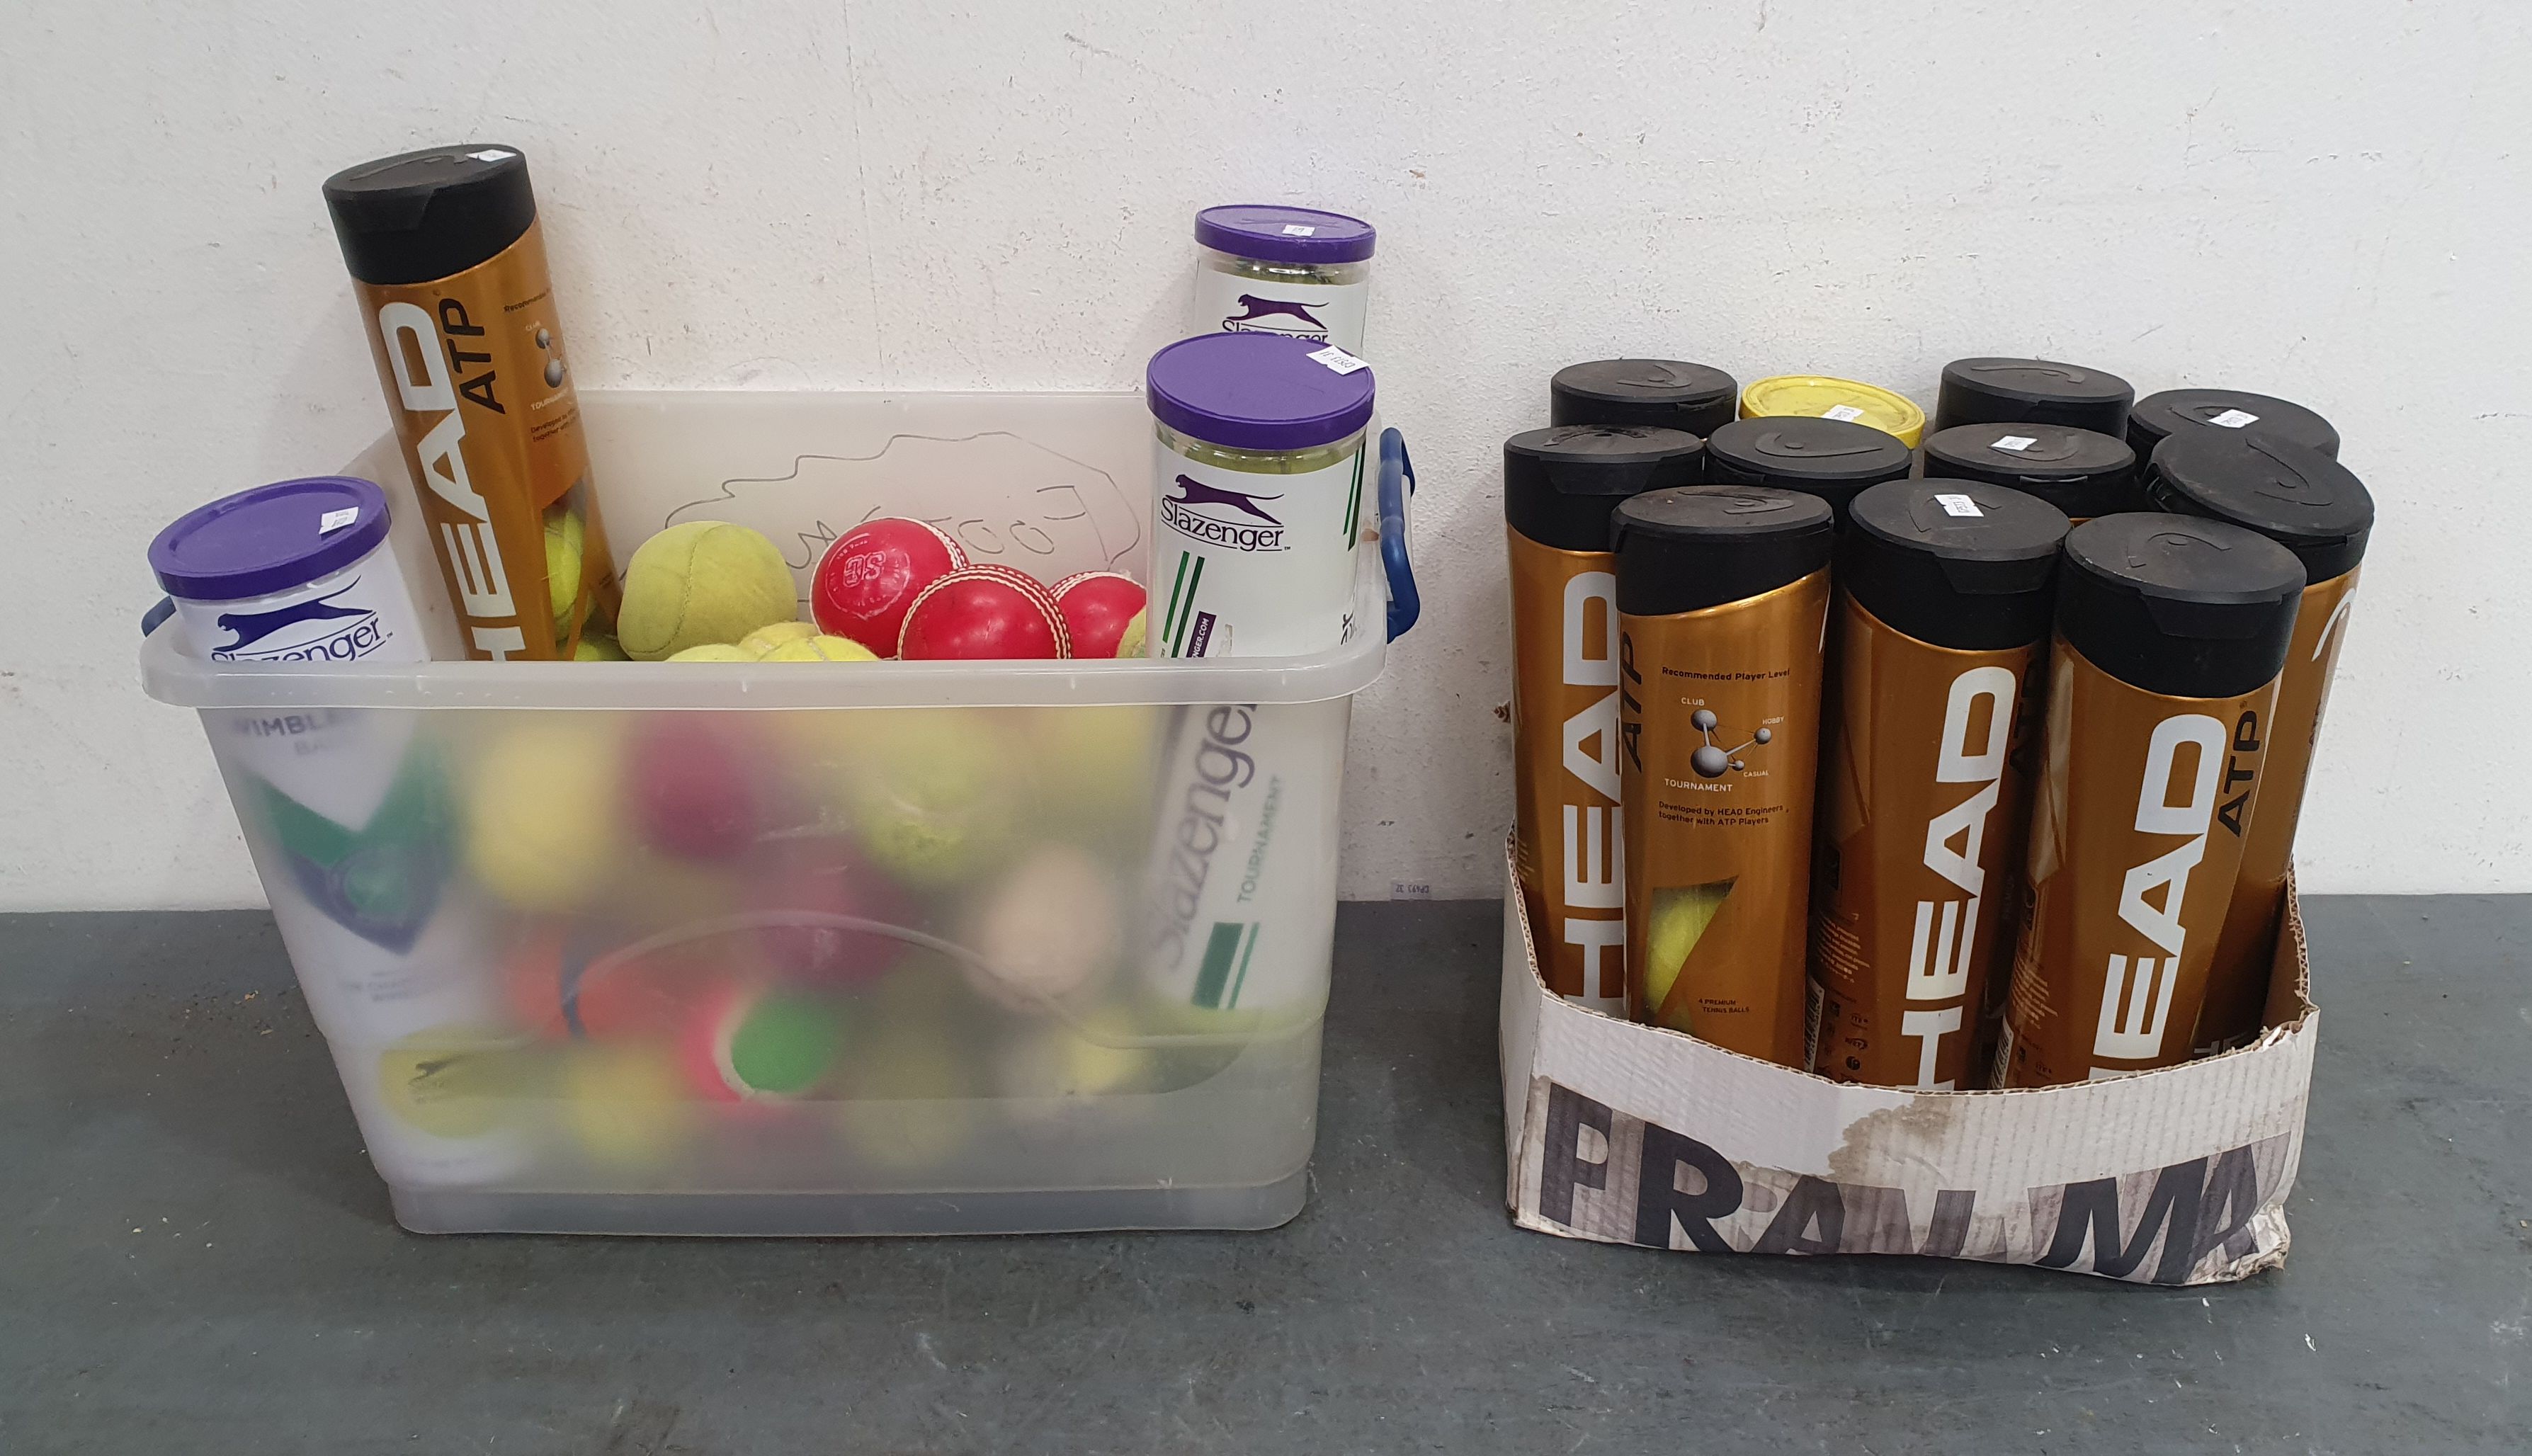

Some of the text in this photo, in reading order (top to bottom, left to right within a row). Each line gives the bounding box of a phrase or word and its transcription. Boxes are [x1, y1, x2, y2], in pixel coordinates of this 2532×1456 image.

[438, 298, 506, 414] ATP
[1161, 497, 1285, 552] Slazenger
[1662, 666, 1790, 681] Recommended Player Level
[1621, 632, 1642, 775] ATP
[1681, 697, 1705, 706] CLUB
[1762, 716, 1785, 725] HOBBY
[1664, 778, 1733, 792] TOURNAMENT
[2218, 710, 2261, 838] ATP
[1659, 801, 1701, 814] Developed
[1745, 804, 1783, 816] Engineers
[1659, 810, 1693, 824] together
[1738, 817, 1769, 826] Players
[1237, 774, 1283, 904] TOURNAMENT
[1895, 666, 2017, 1091] HEAD
[2088, 714, 2227, 1081] EAD
